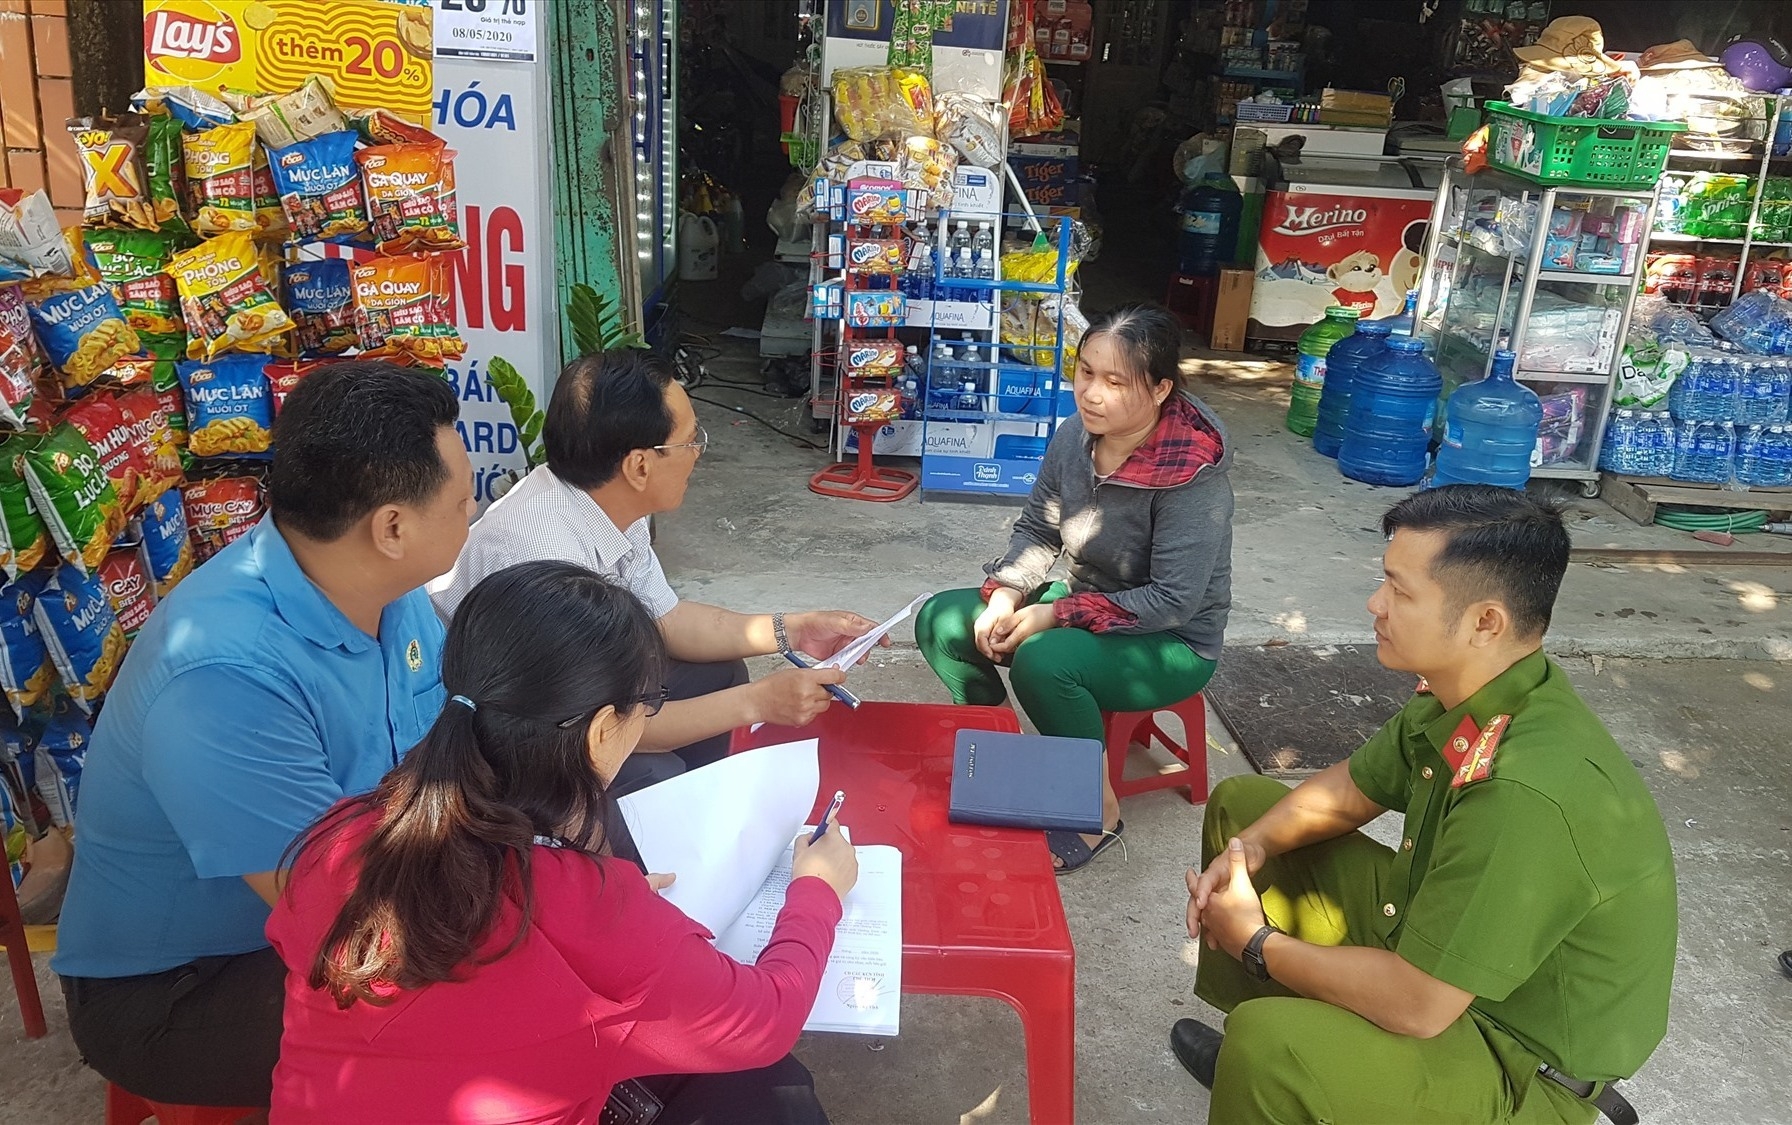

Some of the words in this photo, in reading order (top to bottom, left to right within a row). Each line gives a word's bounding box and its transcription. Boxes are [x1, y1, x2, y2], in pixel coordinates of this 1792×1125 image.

[149, 12, 234, 59] Lay's
[452, 27, 513, 43] 08/05/2020
[276, 37, 343, 62] thêm
[1024, 161, 1064, 182] Tiger
[1025, 184, 1065, 205] Tiger
[1282, 204, 1367, 229] Merino
[1697, 193, 1741, 221] Sprite
[380, 281, 421, 296] QUAY
[370, 299, 382, 307] DA
[1004, 384, 1042, 397] AQUAFINA
[920, 436, 967, 449] AQUAFINA
